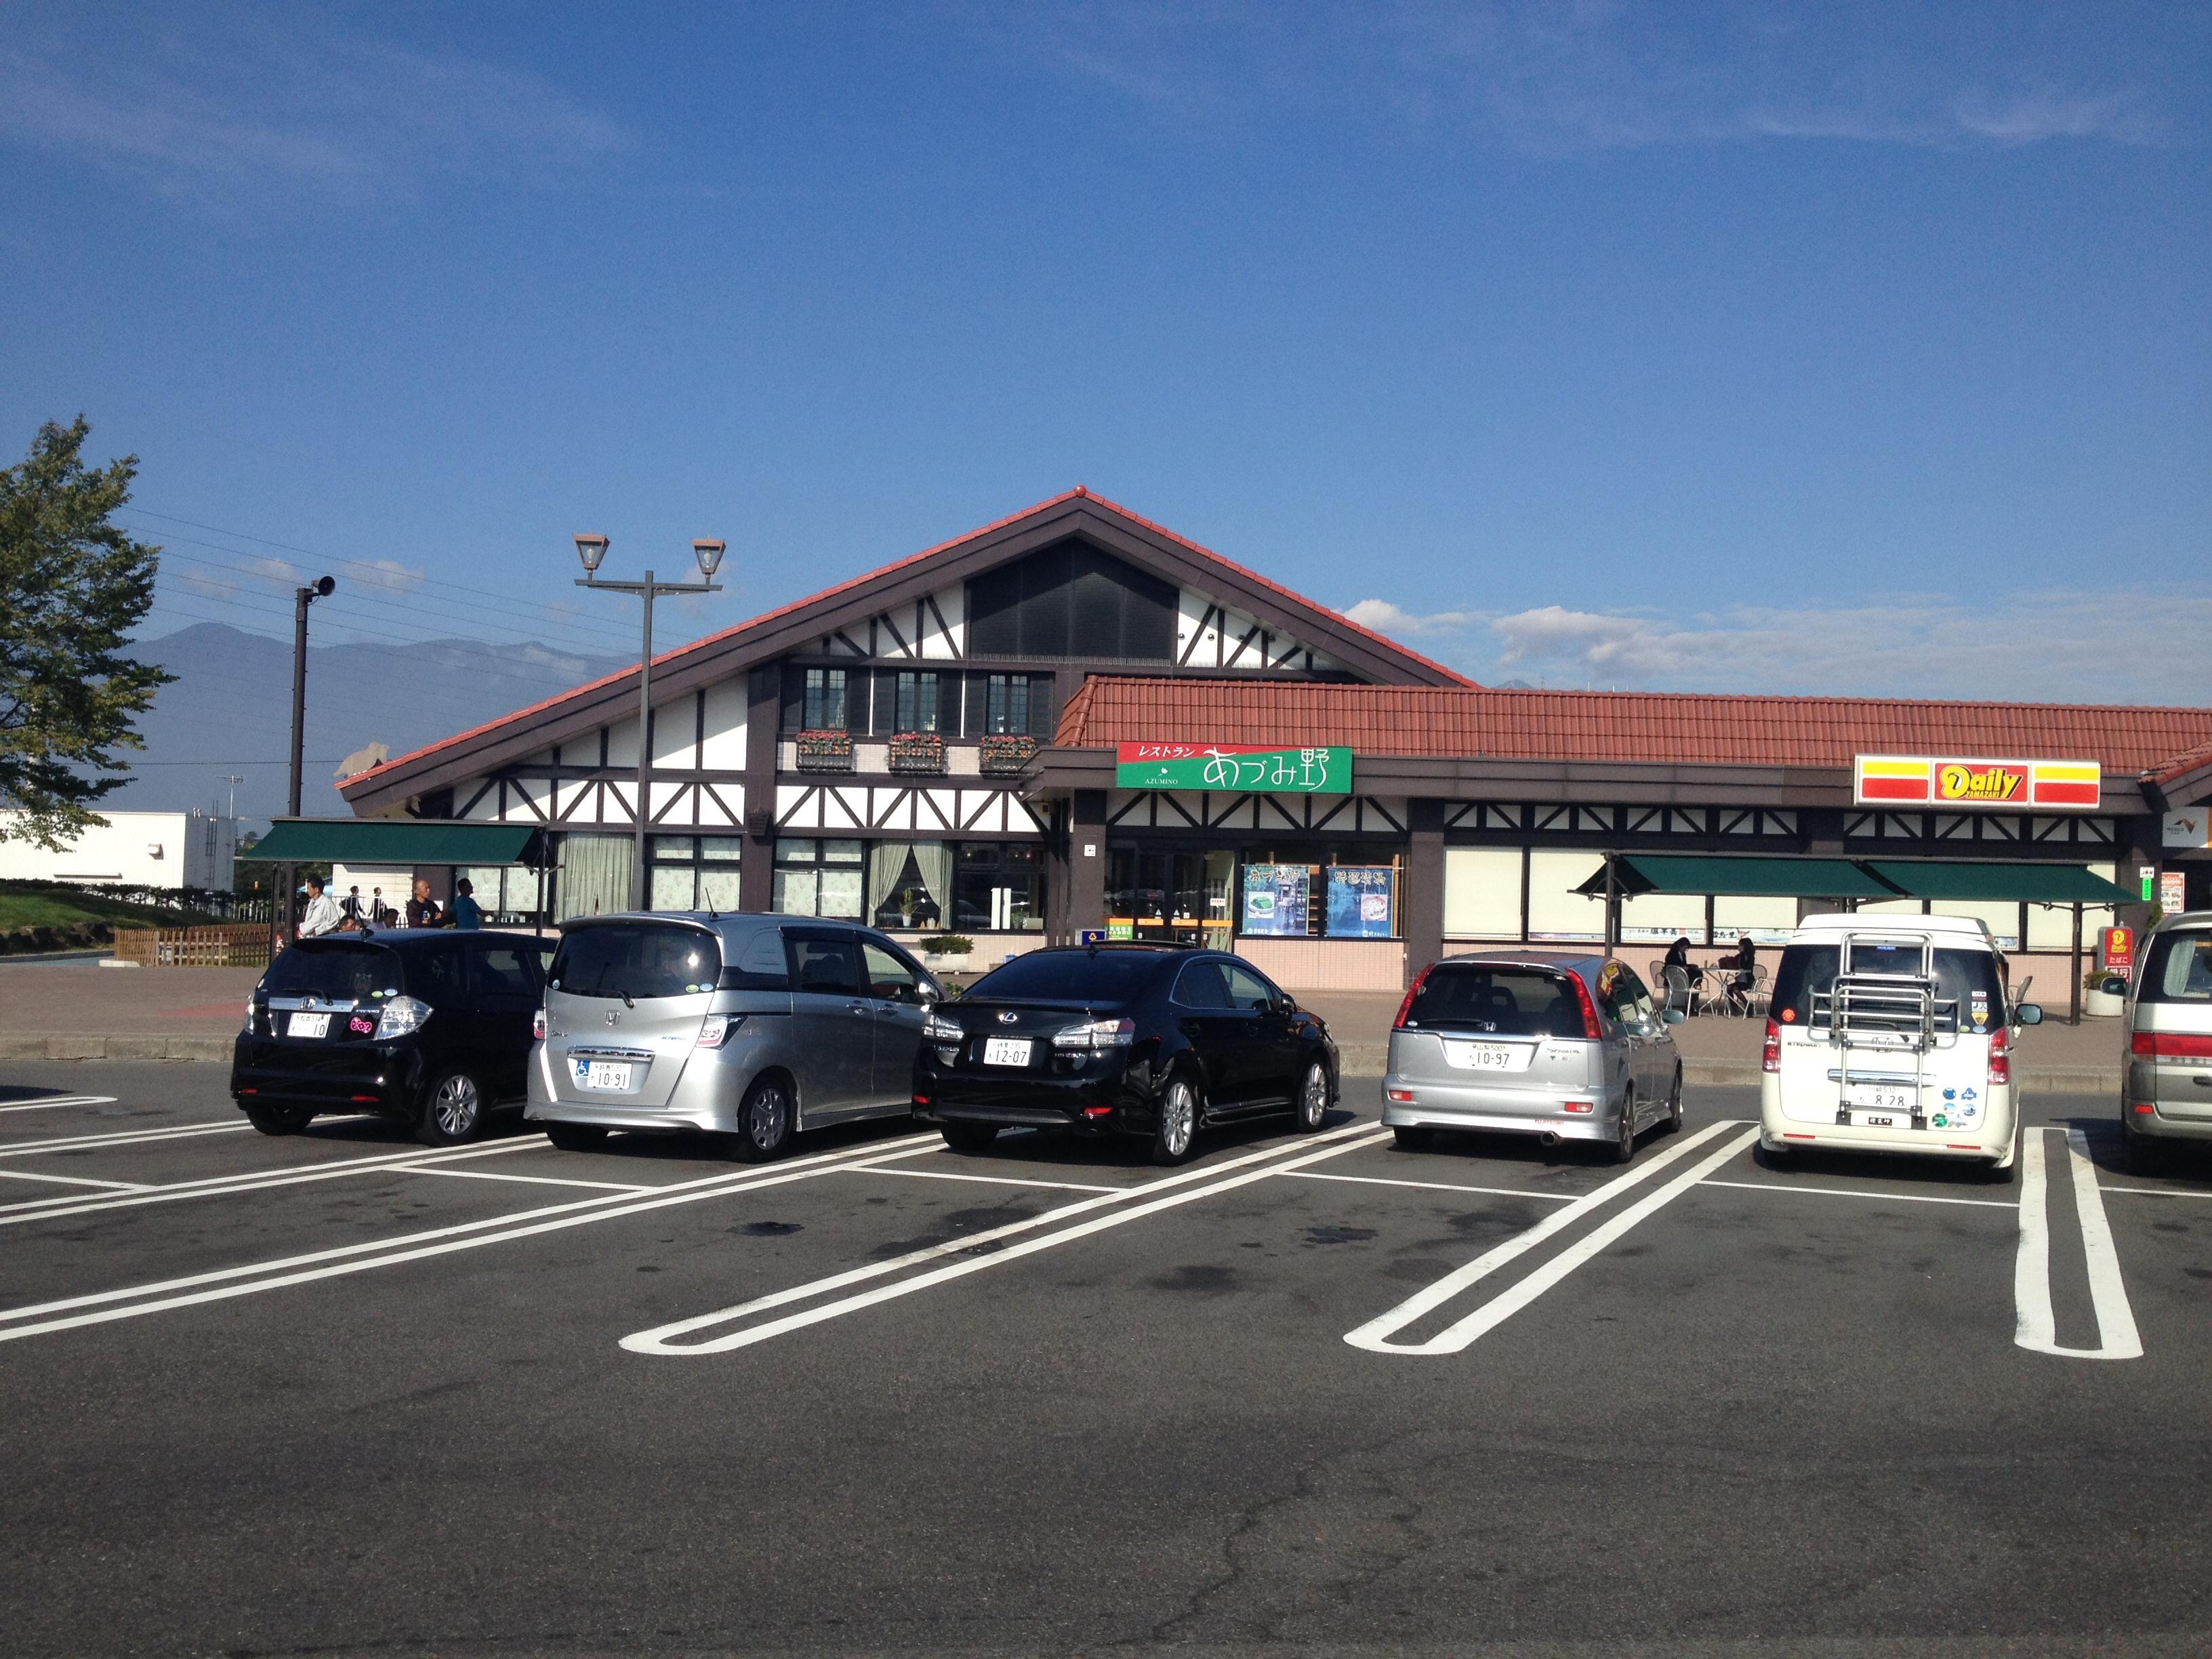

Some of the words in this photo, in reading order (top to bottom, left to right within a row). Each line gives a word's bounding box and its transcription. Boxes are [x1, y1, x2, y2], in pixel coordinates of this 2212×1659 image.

[1138, 745, 1196, 758] レストラン
[1203, 746, 1330, 791] あづみ野
[1940, 765, 2023, 798] Daily
[313, 1024, 325, 1036] 10
[996, 1050, 1027, 1063] 12-07
[1477, 1052, 1510, 1065] 10-97
[598, 1073, 626, 1086] 10-91
